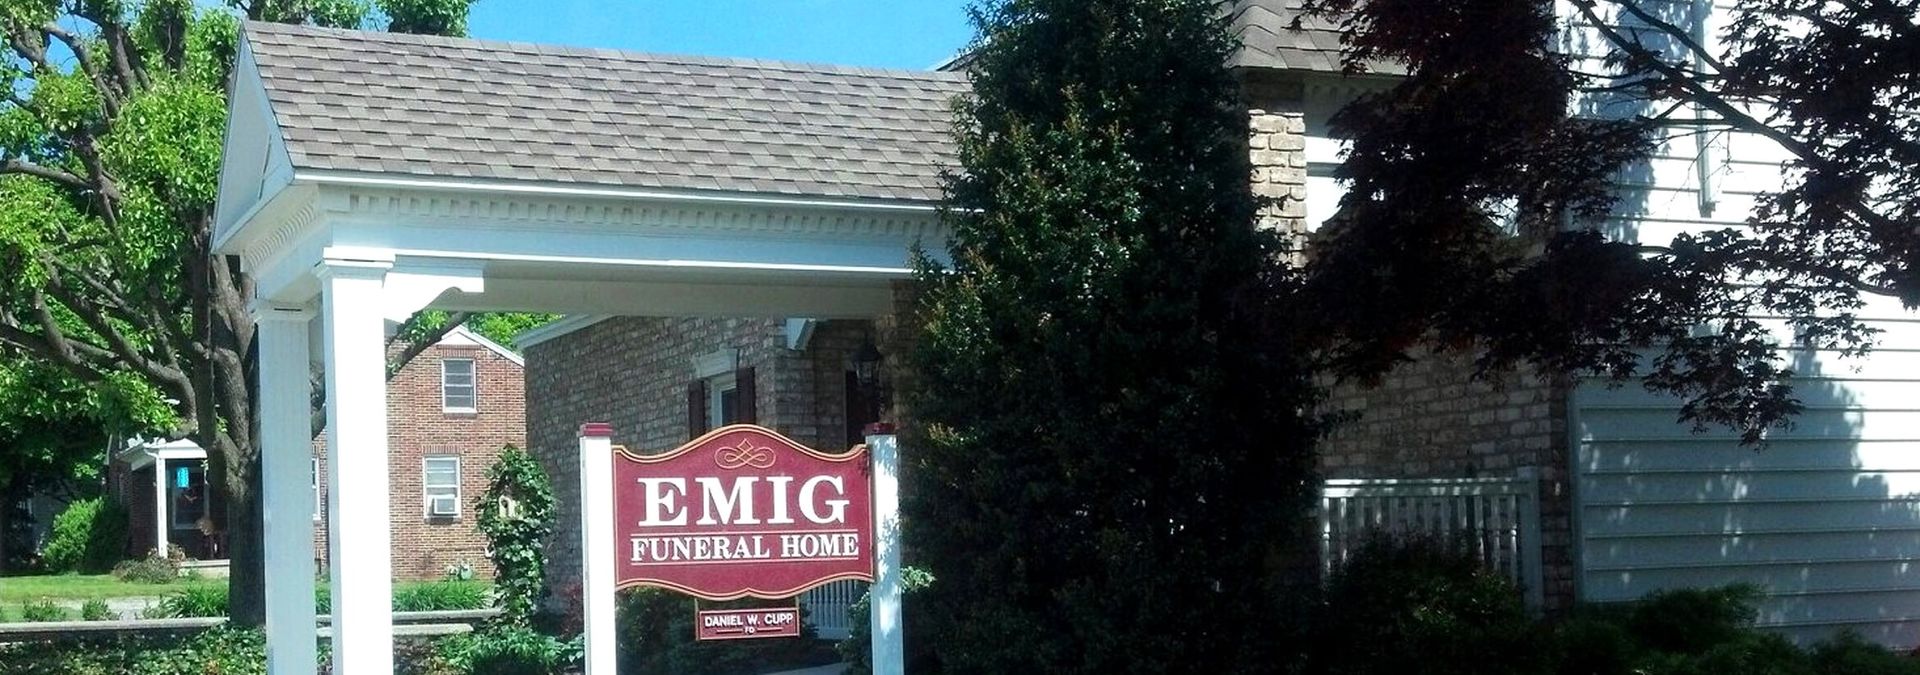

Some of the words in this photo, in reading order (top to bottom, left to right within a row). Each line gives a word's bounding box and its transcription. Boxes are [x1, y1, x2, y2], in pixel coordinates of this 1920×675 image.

[637, 474, 850, 527] EMIG
[630, 535, 770, 562] FUNERAL
[780, 532, 859, 559] HOME
[704, 615, 743, 628] DANIEL
[746, 614, 761, 626] W.
[764, 612, 794, 625] CUPP
